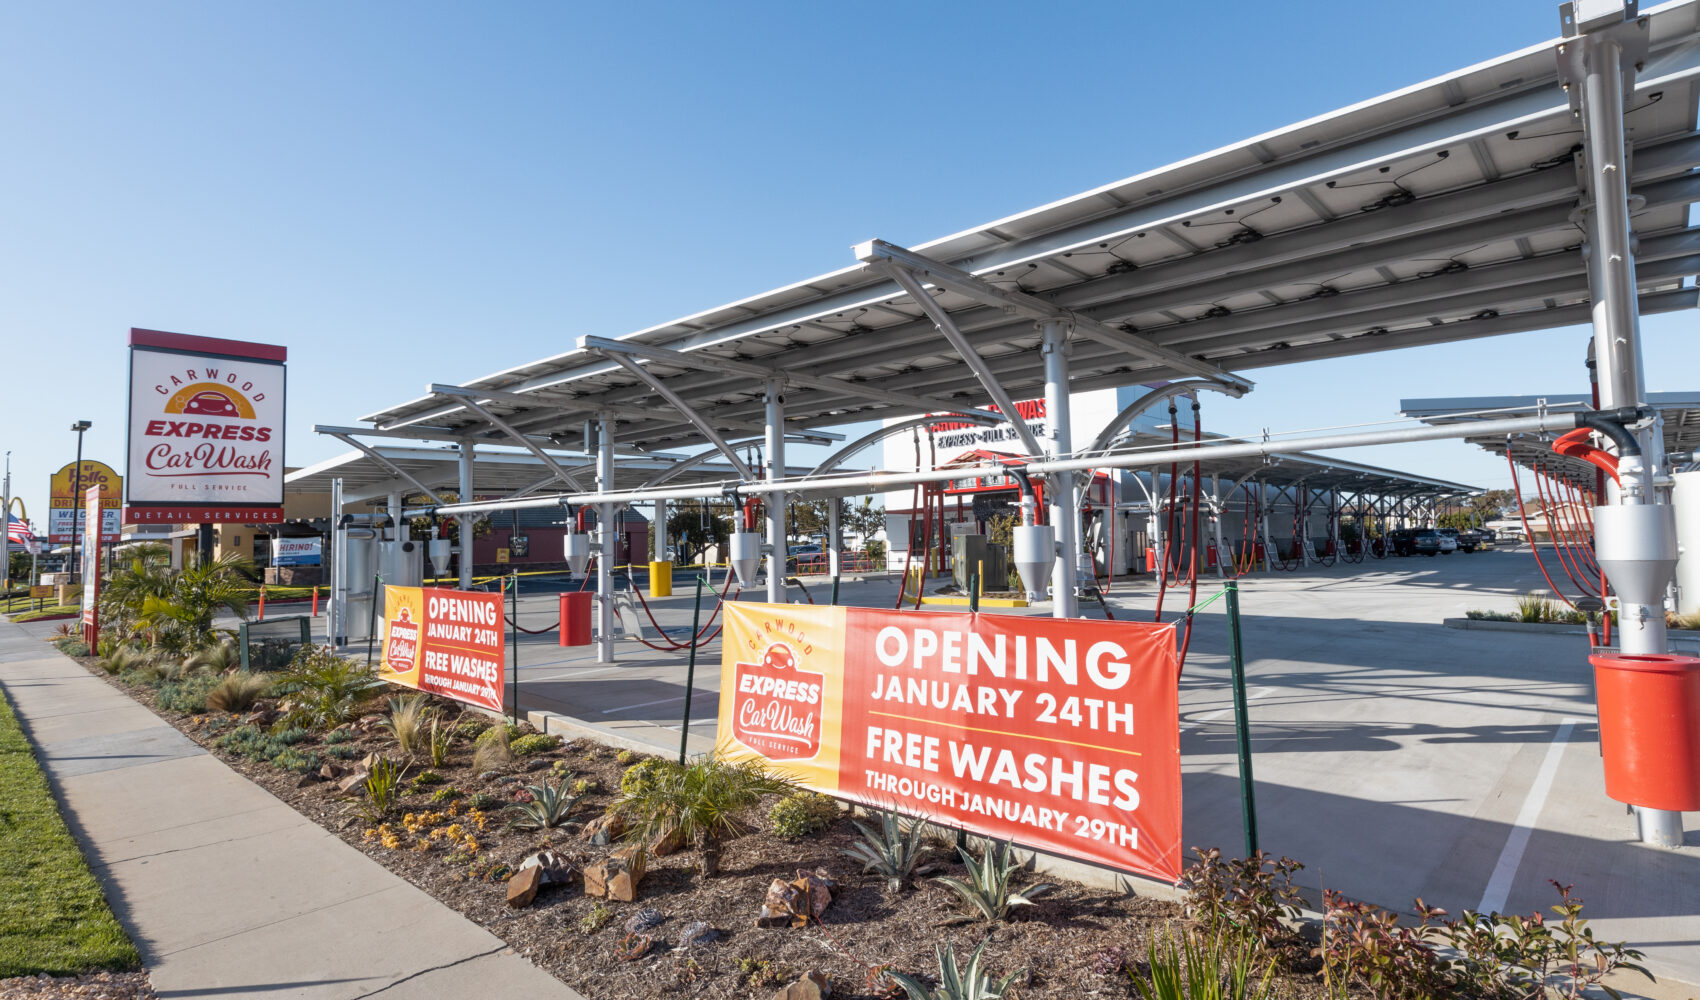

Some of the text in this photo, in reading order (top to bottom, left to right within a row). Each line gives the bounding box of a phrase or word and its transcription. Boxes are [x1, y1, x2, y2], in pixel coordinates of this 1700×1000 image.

[155, 368, 265, 402] CARWOOD
[144, 420, 272, 442] EXPRESS
[938, 432, 976, 448] EXPRESS
[983, 429, 1004, 442] FULL
[1006, 423, 1046, 440] SEICE
[145, 442, 272, 471] Car Wash
[54, 499, 86, 508] DRIE
[134, 511, 192, 519] DETAIL
[428, 596, 497, 626] OPENING
[391, 626, 418, 641] EXPRESS
[427, 622, 498, 647] JANUARY 24TH
[749, 619, 813, 656] CARWOOD
[424, 650, 498, 683] FREE WASHES
[875, 626, 1131, 690] OPENING
[424, 673, 452, 689] THROUGH
[452, 679, 481, 696] JANUARY
[738, 673, 821, 705] EXPRESS
[739, 698, 815, 738] Car Wash
[871, 673, 1134, 735] JANUARY 24TH
[768, 741, 799, 755] SERVICE
[866, 726, 1141, 812] FREE WASHES
[865, 769, 1138, 850] THROUGH JANUARY 29TH
